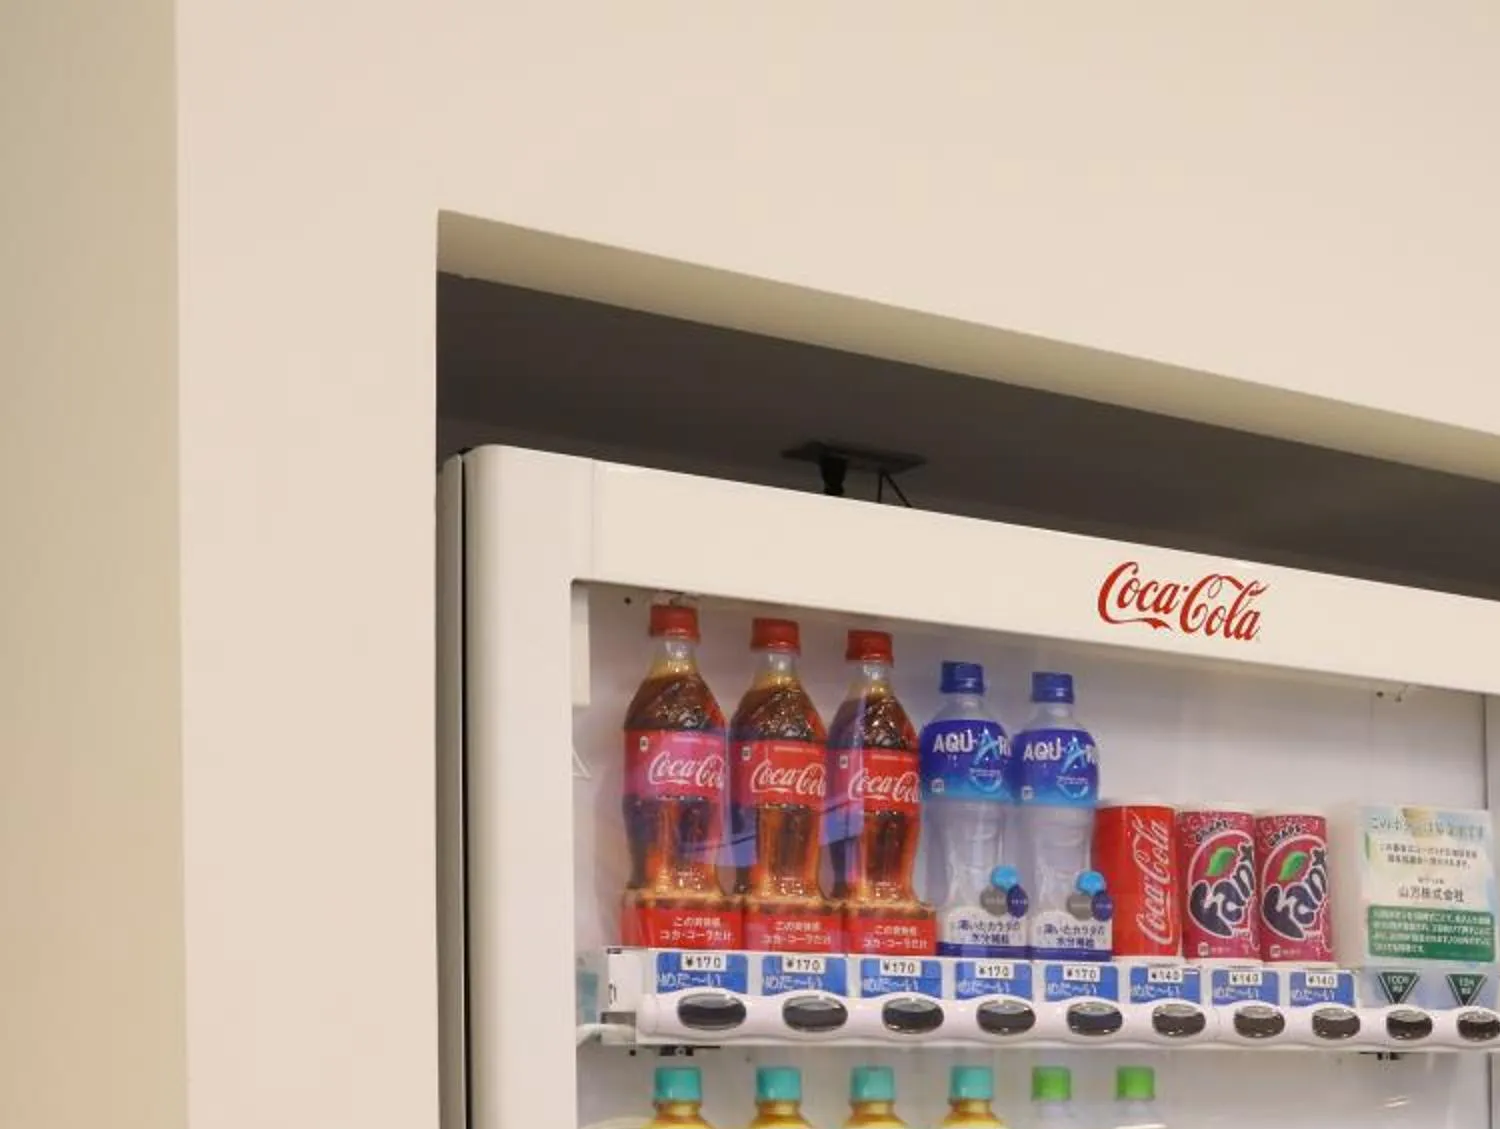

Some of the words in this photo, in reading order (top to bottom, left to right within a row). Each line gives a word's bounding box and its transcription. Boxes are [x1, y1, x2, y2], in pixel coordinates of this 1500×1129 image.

[1098, 561, 1271, 641] Coca-Cola
[685, 956, 722, 969] ¥170
[786, 957, 821, 971] ¥170
[883, 960, 915, 973] ¥170
[977, 963, 1010, 977] ¥170
[1066, 967, 1097, 981] ¥170
